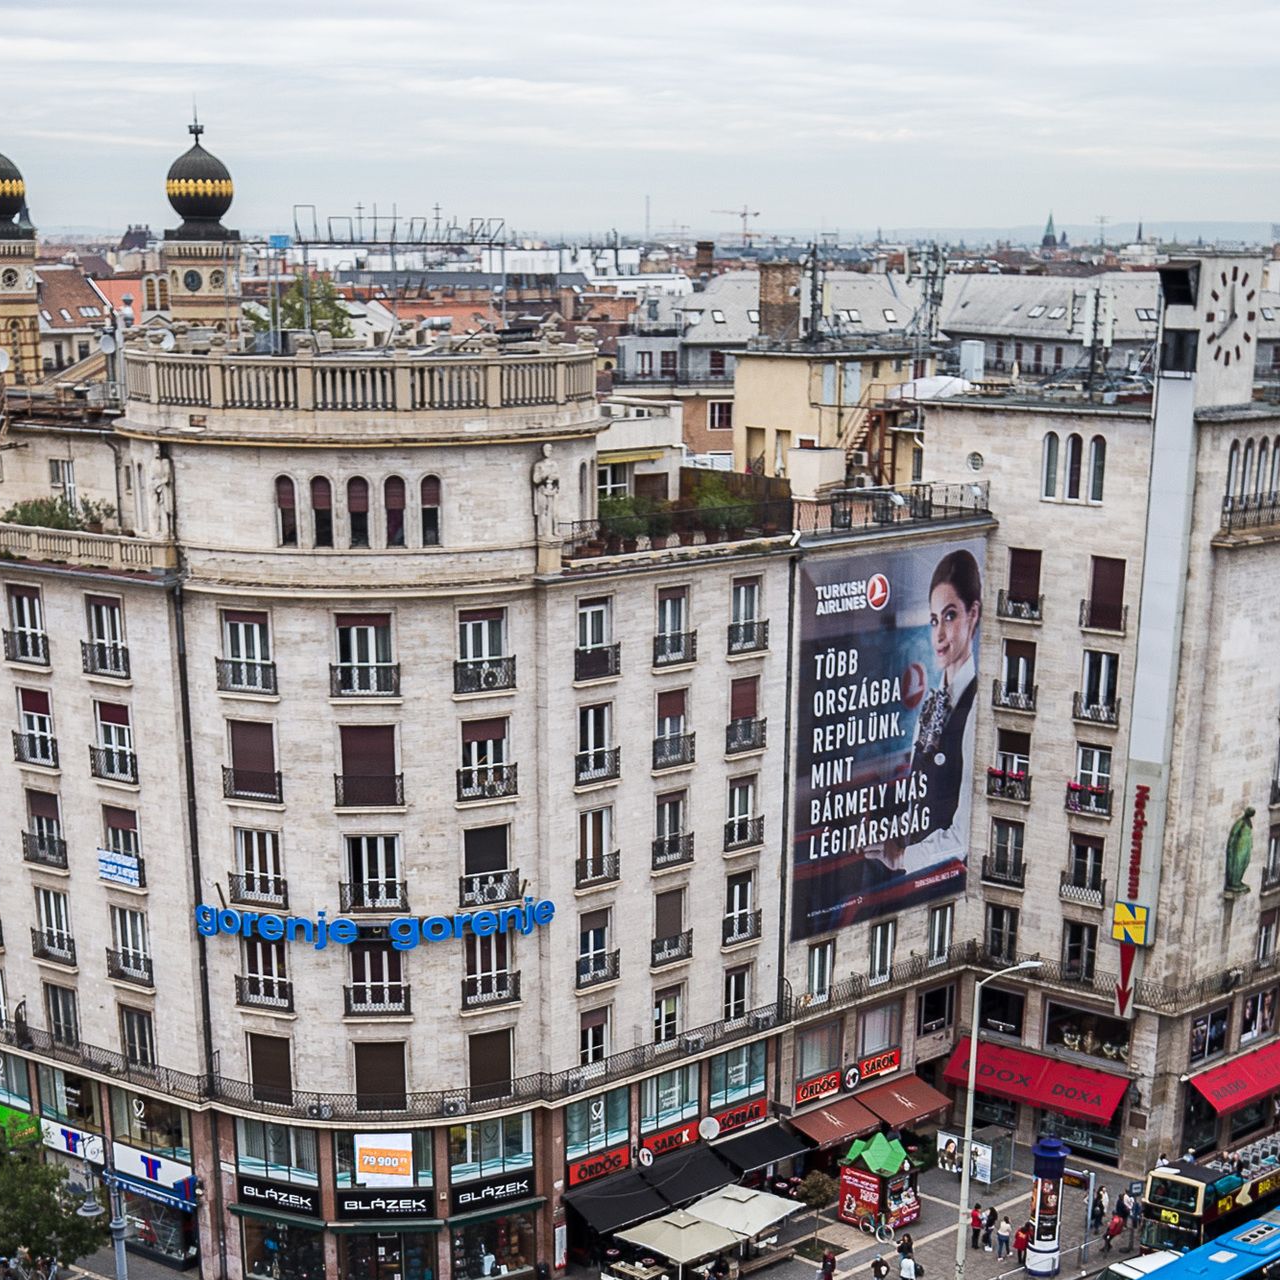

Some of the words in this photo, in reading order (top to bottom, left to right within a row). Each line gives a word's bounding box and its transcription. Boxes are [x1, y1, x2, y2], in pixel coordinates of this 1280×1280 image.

[816, 580, 866, 600] TURKISH
[816, 595, 866, 615] AIRLINES
[814, 648, 858, 680] TÖBB
[814, 677, 901, 717] ORSZÁGBA
[812, 712, 906, 753] REPÜLÜNK.
[811, 757, 854, 789] MINT
[811, 783, 888, 825] BÁRMELY
[895, 771, 928, 804] MÁS
[810, 804, 930, 860] LÉGITÁRSASÁG
[1127, 785, 1150, 900] Neckermann
[195, 904, 358, 950] gorenje
[389, 897, 556, 950] gorenje
[800, 1076, 837, 1099] ÖRDÖG
[864, 1052, 896, 1075] SAROK
[1051, 1084, 1102, 1106] DOXA
[1211, 1079, 1247, 1100] RADO
[653, 1129, 690, 1151] SAROK
[362, 1155, 376, 1167] 79
[377, 1156, 399, 1168] 900
[578, 1155, 622, 1180] ÖRDÖG
[243, 1185, 312, 1207] BLÁZEK
[344, 1197, 426, 1210] BLÁZEK
[459, 1179, 528, 1203] BLÁZEK
